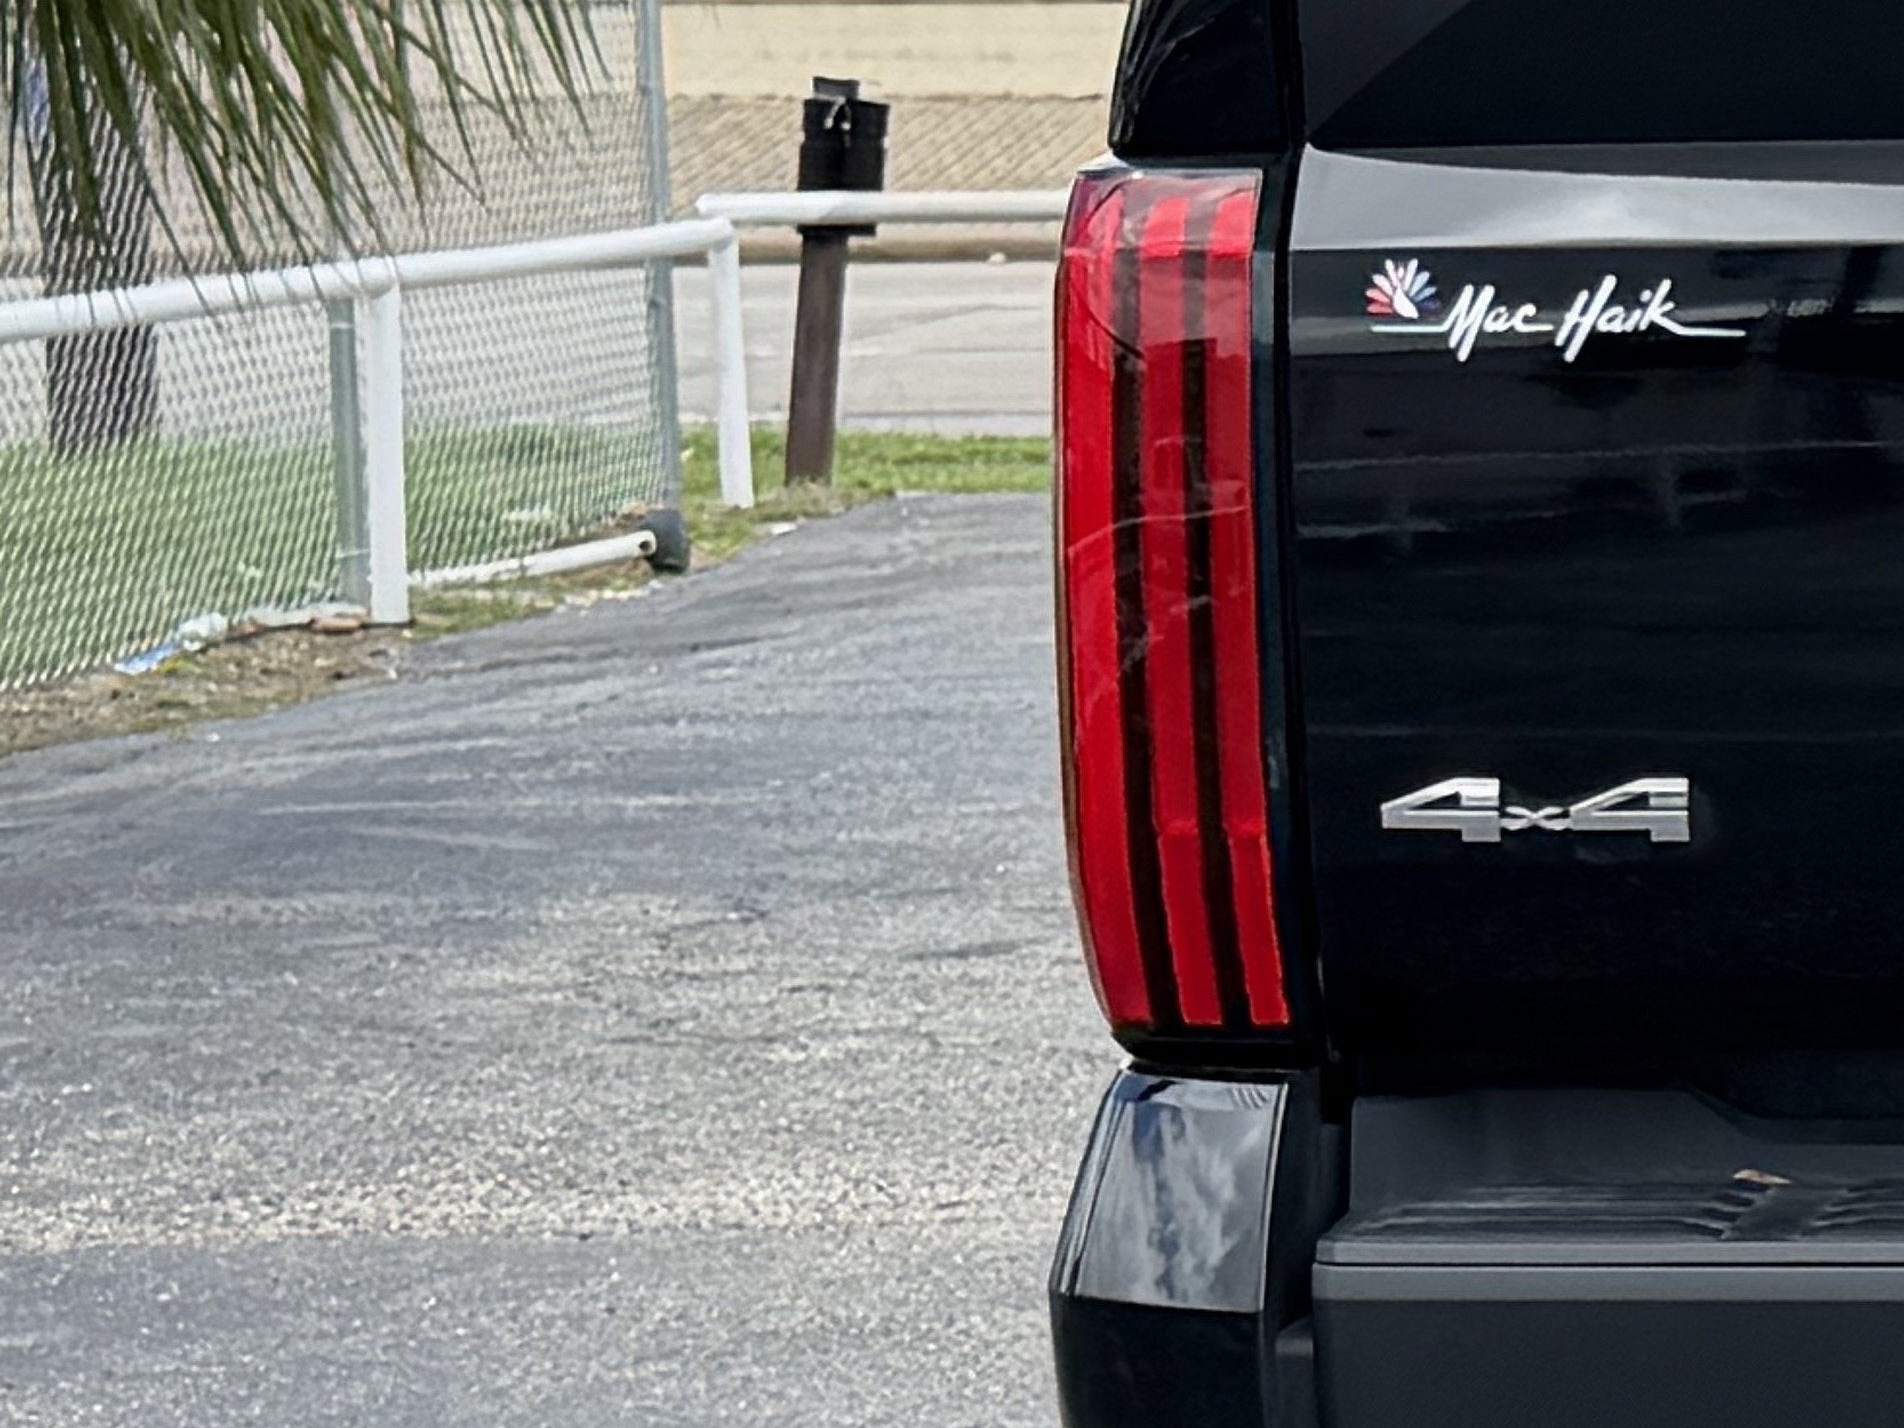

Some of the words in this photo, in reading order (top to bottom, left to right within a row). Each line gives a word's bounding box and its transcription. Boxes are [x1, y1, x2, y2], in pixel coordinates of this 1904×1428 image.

[1371, 283, 1554, 363] Mac
[1555, 274, 1747, 363] Haik
[1379, 776, 1691, 843] 4x4
